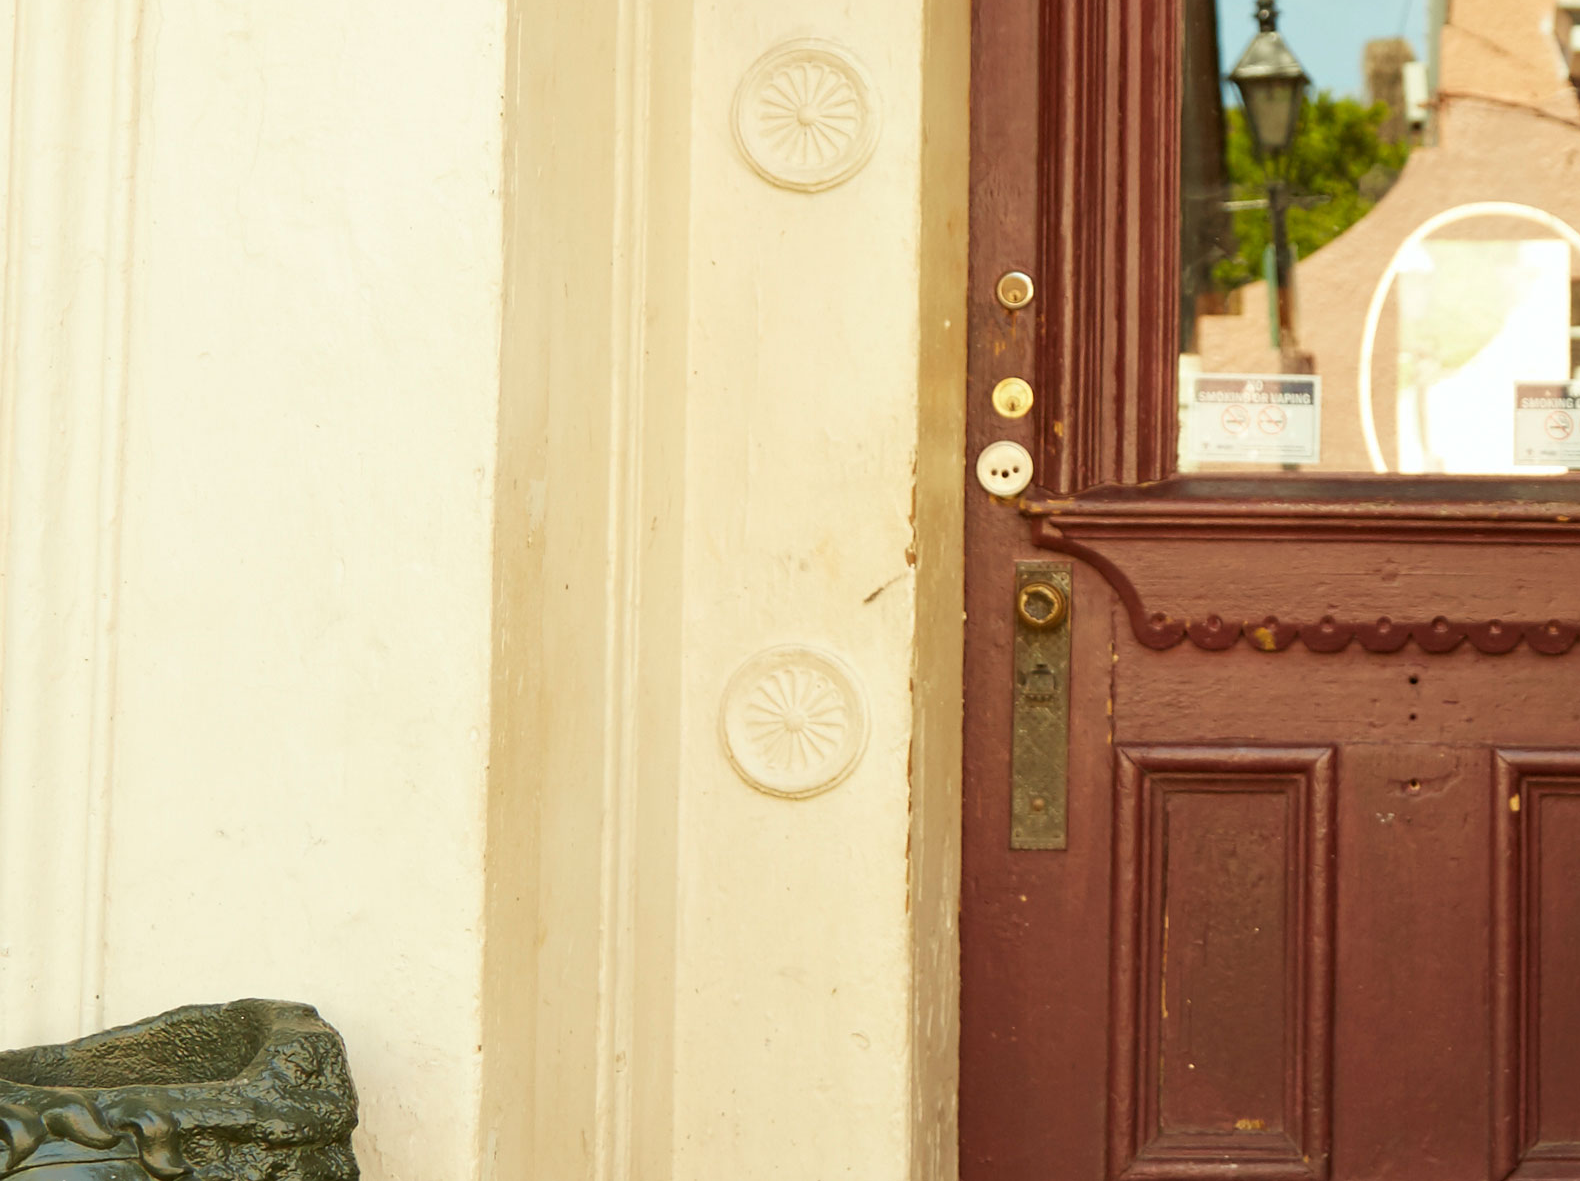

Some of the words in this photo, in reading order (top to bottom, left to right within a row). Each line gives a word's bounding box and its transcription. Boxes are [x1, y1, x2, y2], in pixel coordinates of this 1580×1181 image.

[1199, 390, 1251, 403] SMOKING
[1252, 392, 1268, 403] OR
[1270, 393, 1311, 404] VAPING
[1521, 397, 1573, 408] SMOKING
